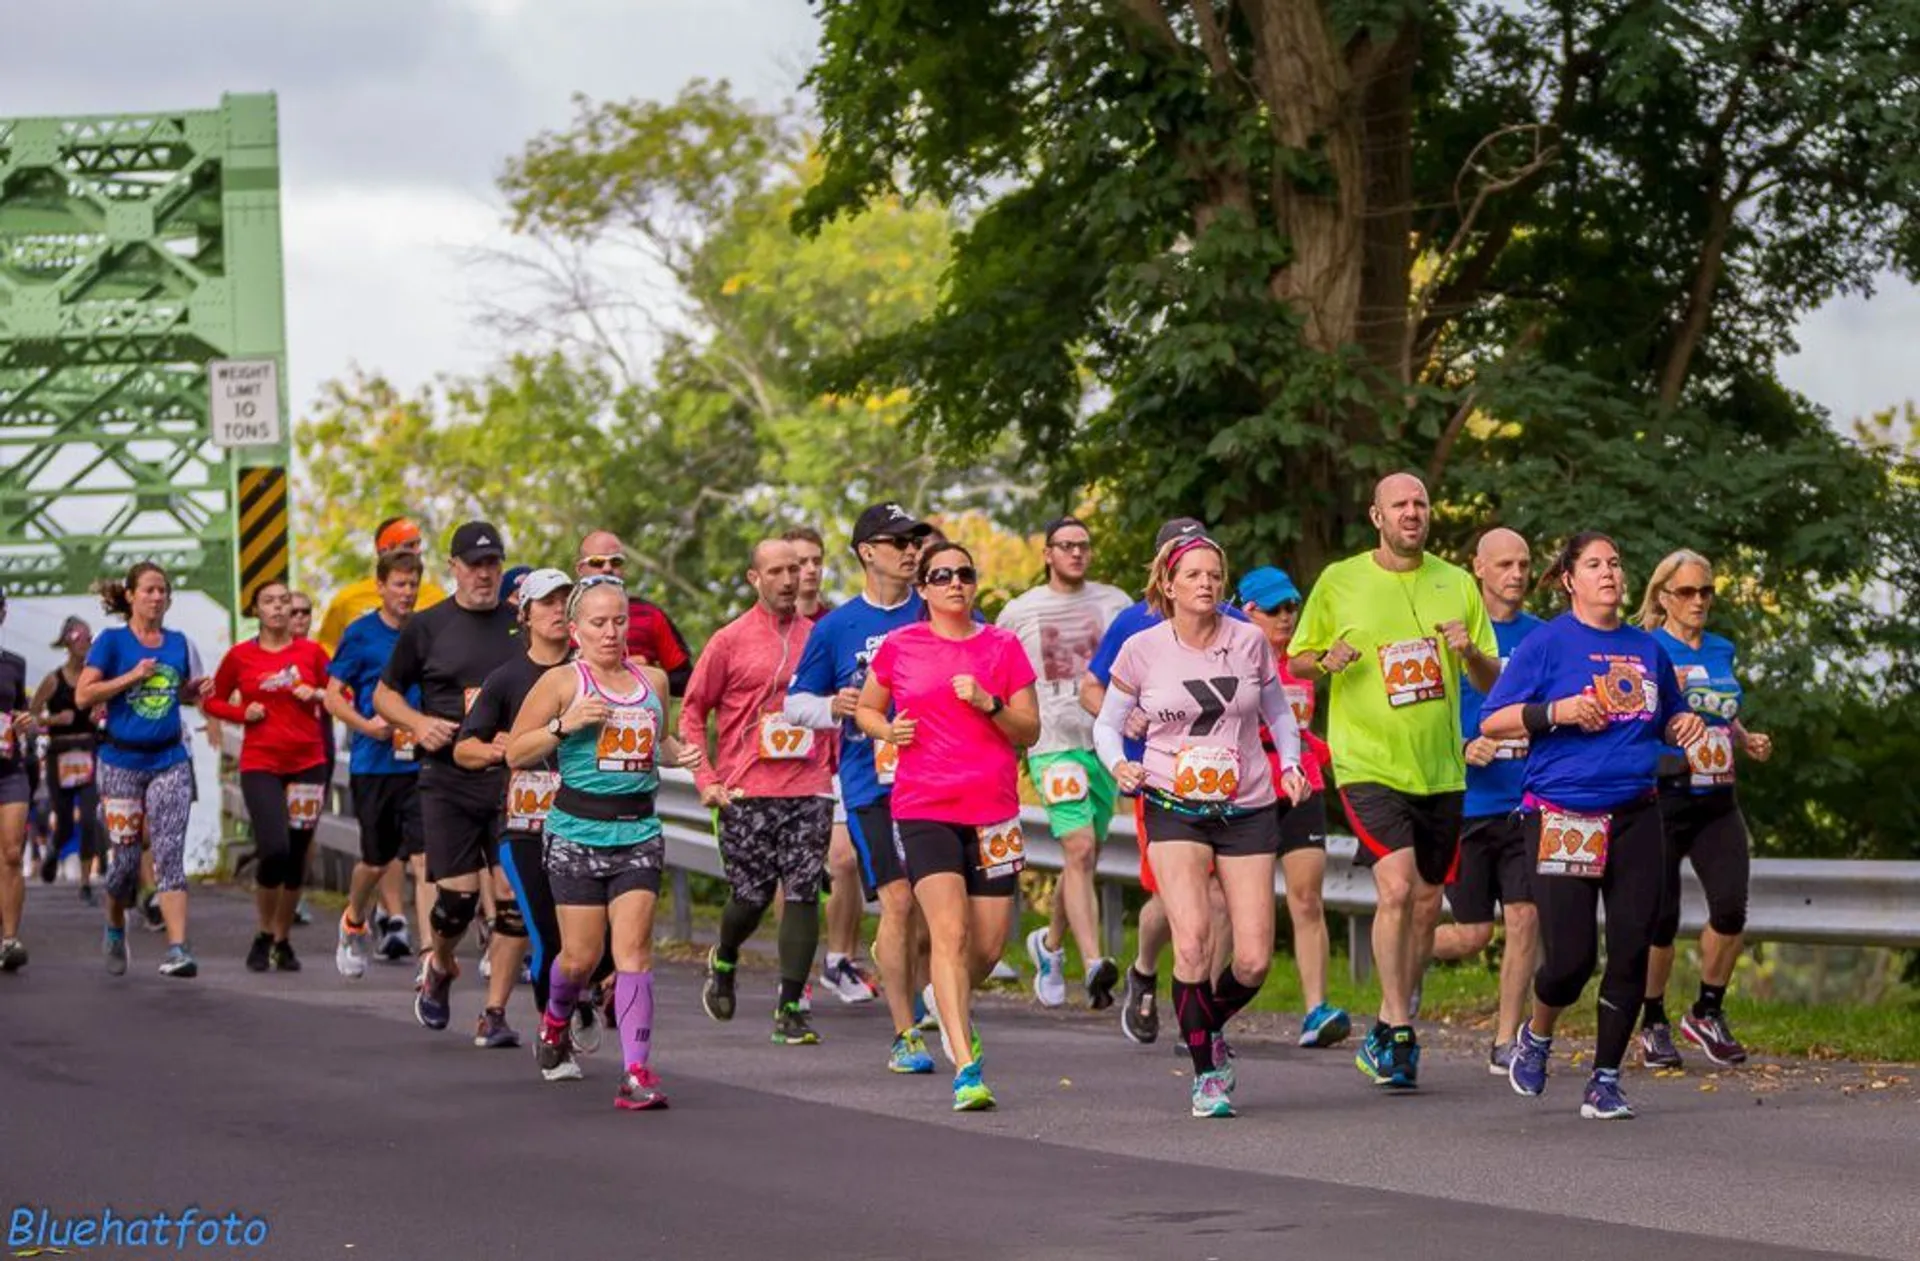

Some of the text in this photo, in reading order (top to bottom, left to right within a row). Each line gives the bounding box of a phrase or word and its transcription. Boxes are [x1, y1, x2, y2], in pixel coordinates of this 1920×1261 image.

[217, 364, 271, 380] WEIGHT
[226, 383, 262, 398] LIMIT
[235, 401, 256, 418] 10
[223, 422, 270, 440] TONS
[1385, 656, 1441, 686] 426
[1158, 708, 1186, 723] the
[771, 728, 806, 752] 97
[1176, 766, 1237, 796] 636
[990, 826, 1024, 857] 60
[1543, 828, 1606, 857] 594
